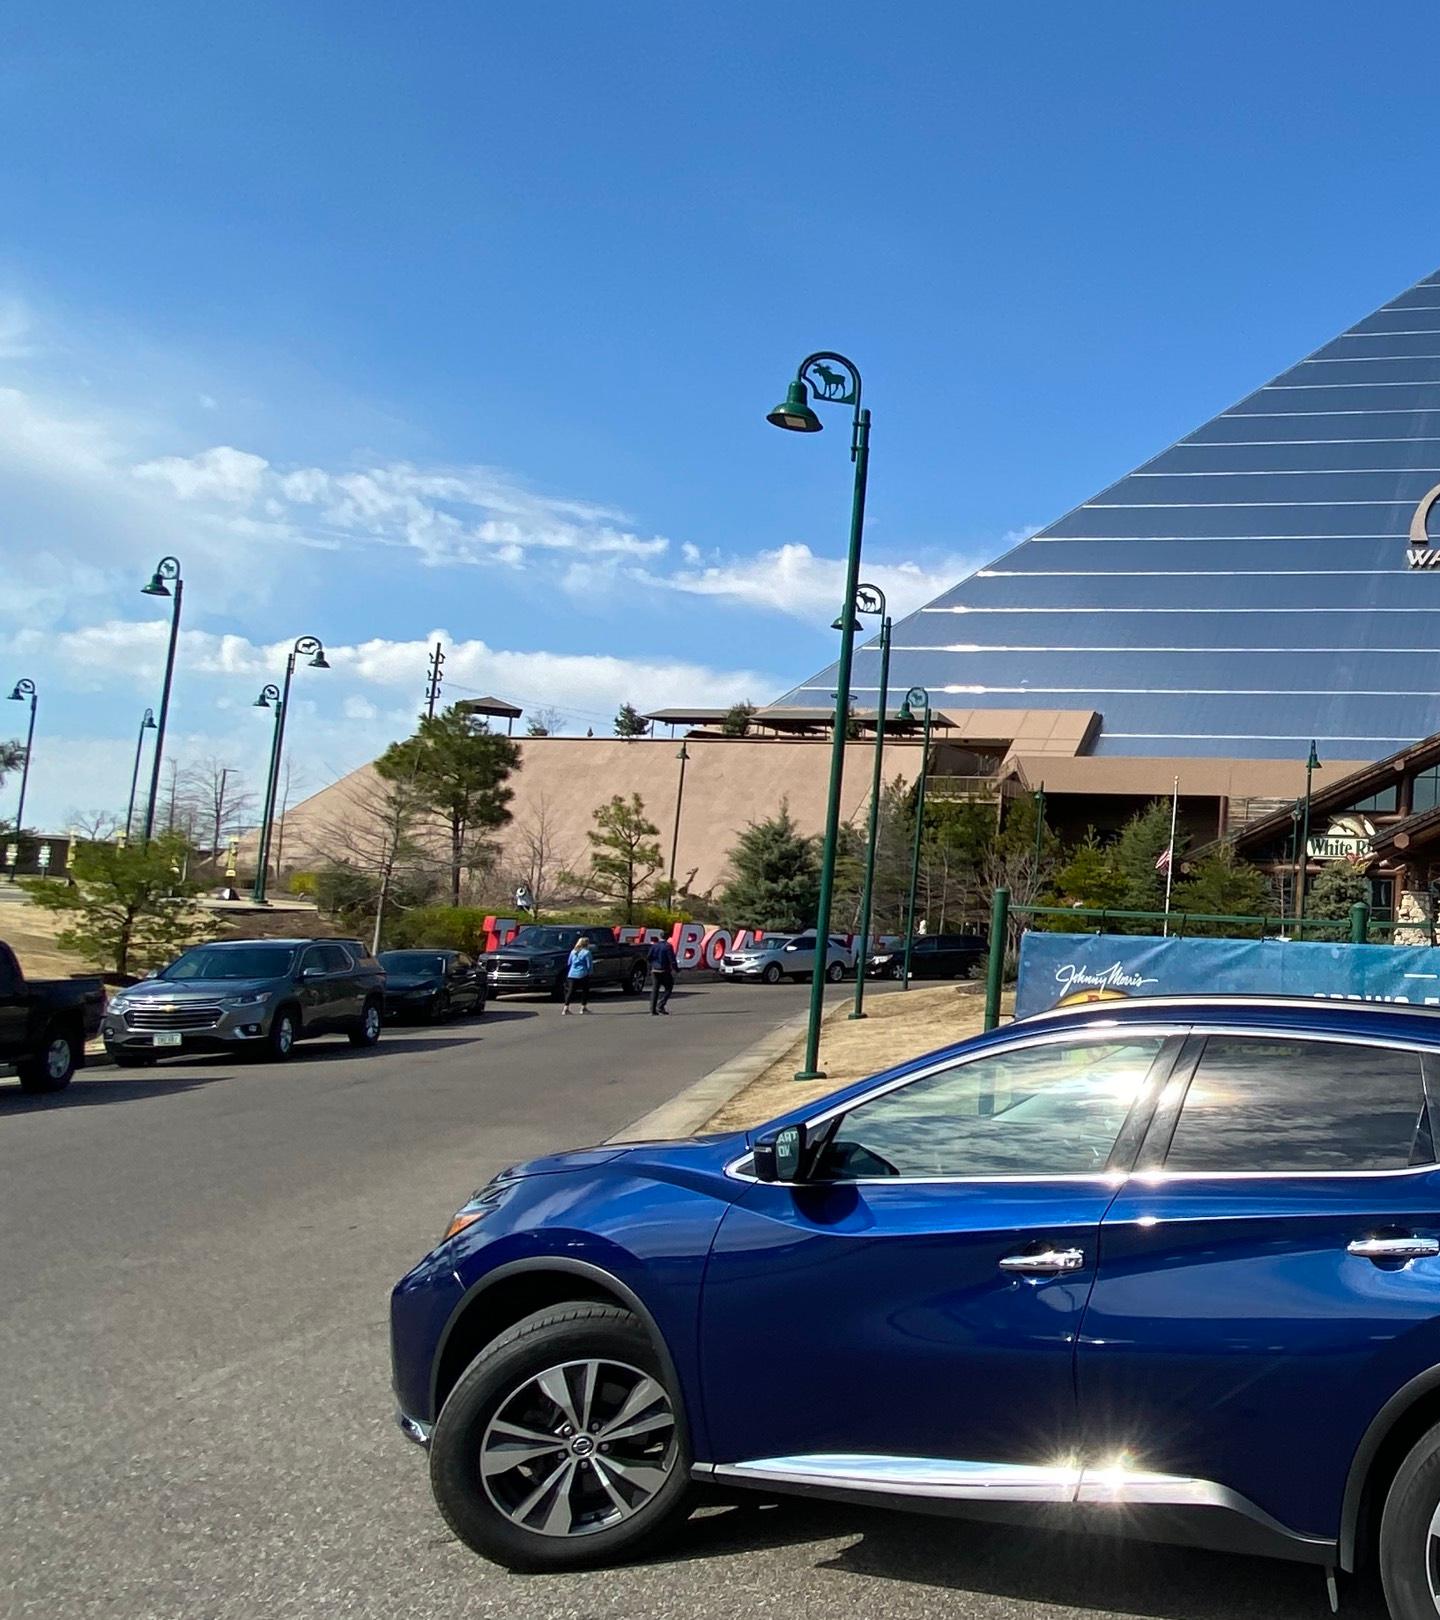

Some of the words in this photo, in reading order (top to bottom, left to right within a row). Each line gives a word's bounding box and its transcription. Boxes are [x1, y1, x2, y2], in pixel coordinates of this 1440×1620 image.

[1310, 838, 1353, 857] White
[1055, 964, 1108, 997] Johnny
[1096, 960, 1159, 987] Morris
